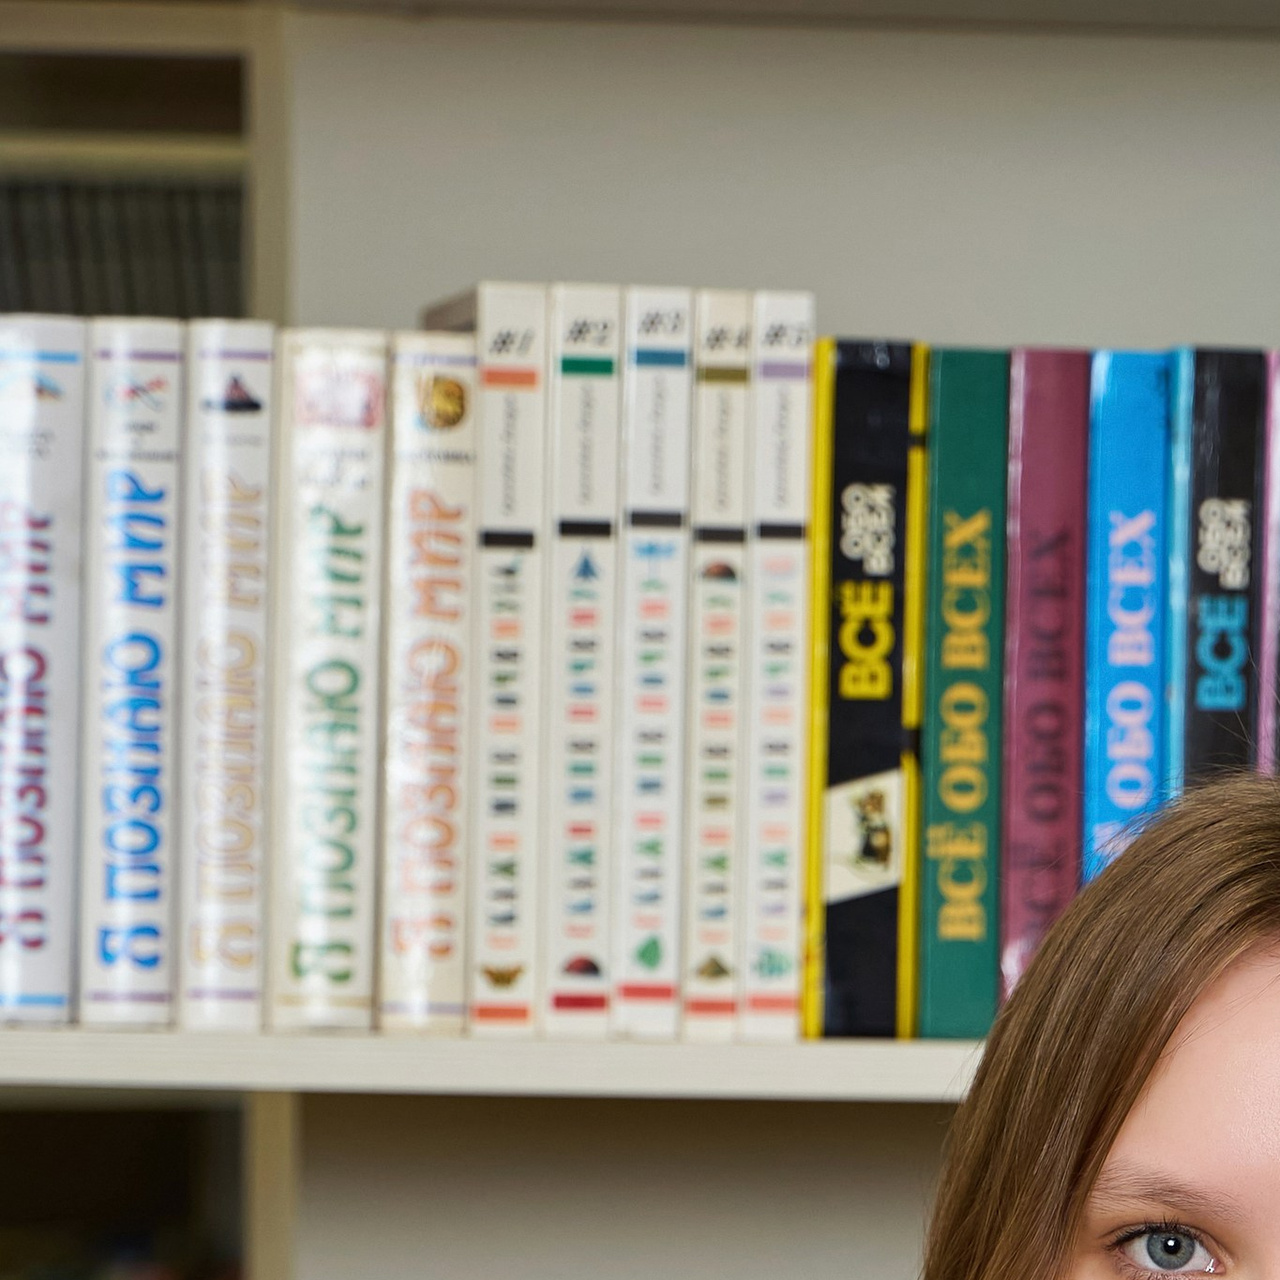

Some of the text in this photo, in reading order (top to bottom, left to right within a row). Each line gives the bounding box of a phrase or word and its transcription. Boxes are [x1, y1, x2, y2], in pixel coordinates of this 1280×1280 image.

[103, 469, 167, 610] МИР
[941, 508, 992, 671] ВСЕХ
[1022, 527, 1072, 686] ВСЕХ
[1106, 509, 1160, 810] ОБО ВСЕХ
[103, 633, 161, 902] ПОЗНАЮ
[196, 632, 258, 898] ПОЗНАЮ
[302, 659, 360, 921] ПОЗНАЮ
[938, 681, 988, 813] ОБО
[1018, 701, 1068, 825] ОБО
[98, 926, 161, 970] Я
